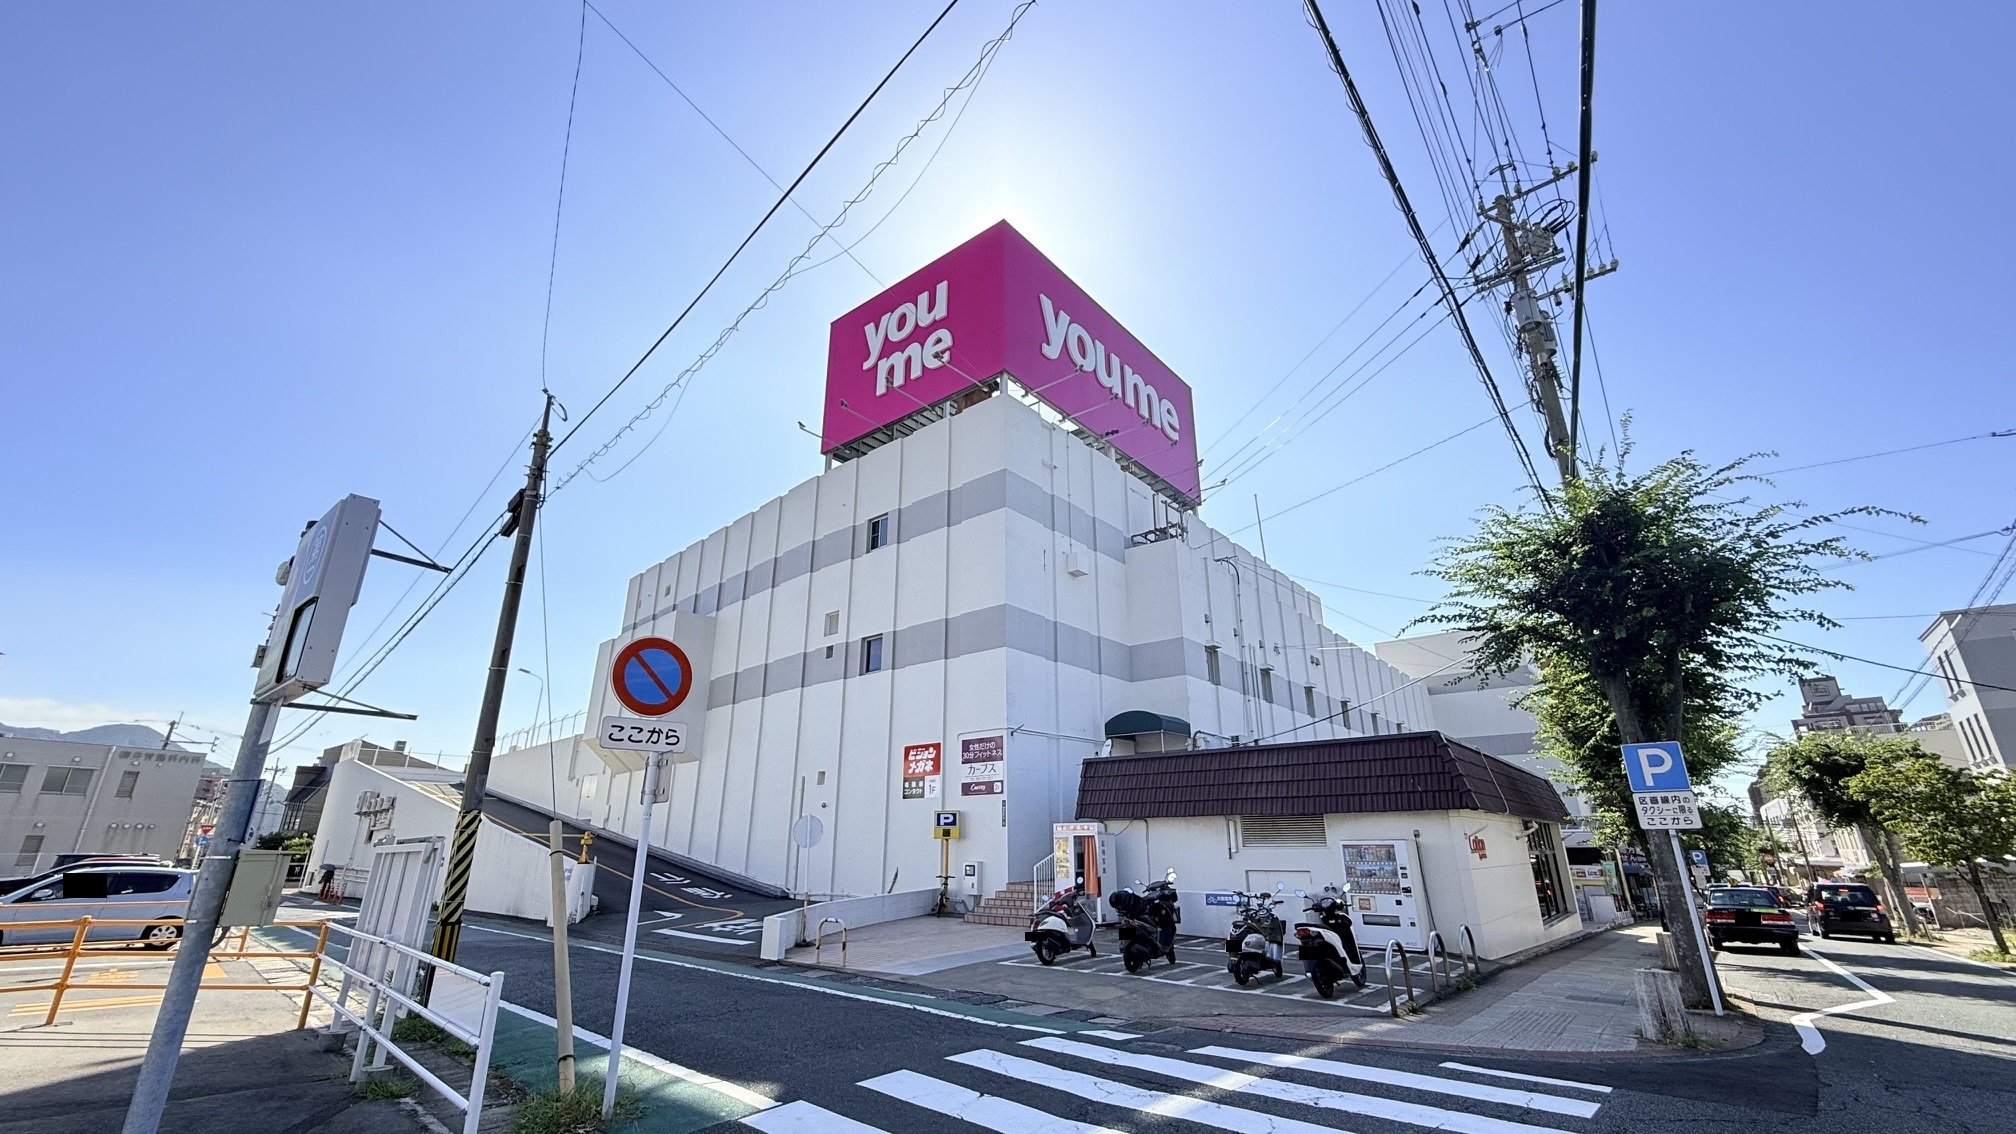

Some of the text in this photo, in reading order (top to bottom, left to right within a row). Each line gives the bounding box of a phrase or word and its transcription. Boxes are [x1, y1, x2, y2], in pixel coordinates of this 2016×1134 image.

[862, 280, 949, 371] you
[876, 327, 954, 397] me
[608, 724, 680, 746] ここから
[969, 741, 996, 751] 女性だけの
[908, 747, 936, 760] ビジョン
[962, 749, 1002, 760] 30分フィットネス
[908, 760, 933, 773] メガネ
[968, 763, 997, 776] カーブス
[1637, 747, 1673, 787] P
[928, 784, 936, 795] 1F
[1638, 795, 1691, 806] 区画線内の
[1641, 804, 1694, 815] タクシーに限る
[940, 813, 954, 826] P
[1646, 816, 1694, 826] ここから
[1692, 851, 1703, 864] P
